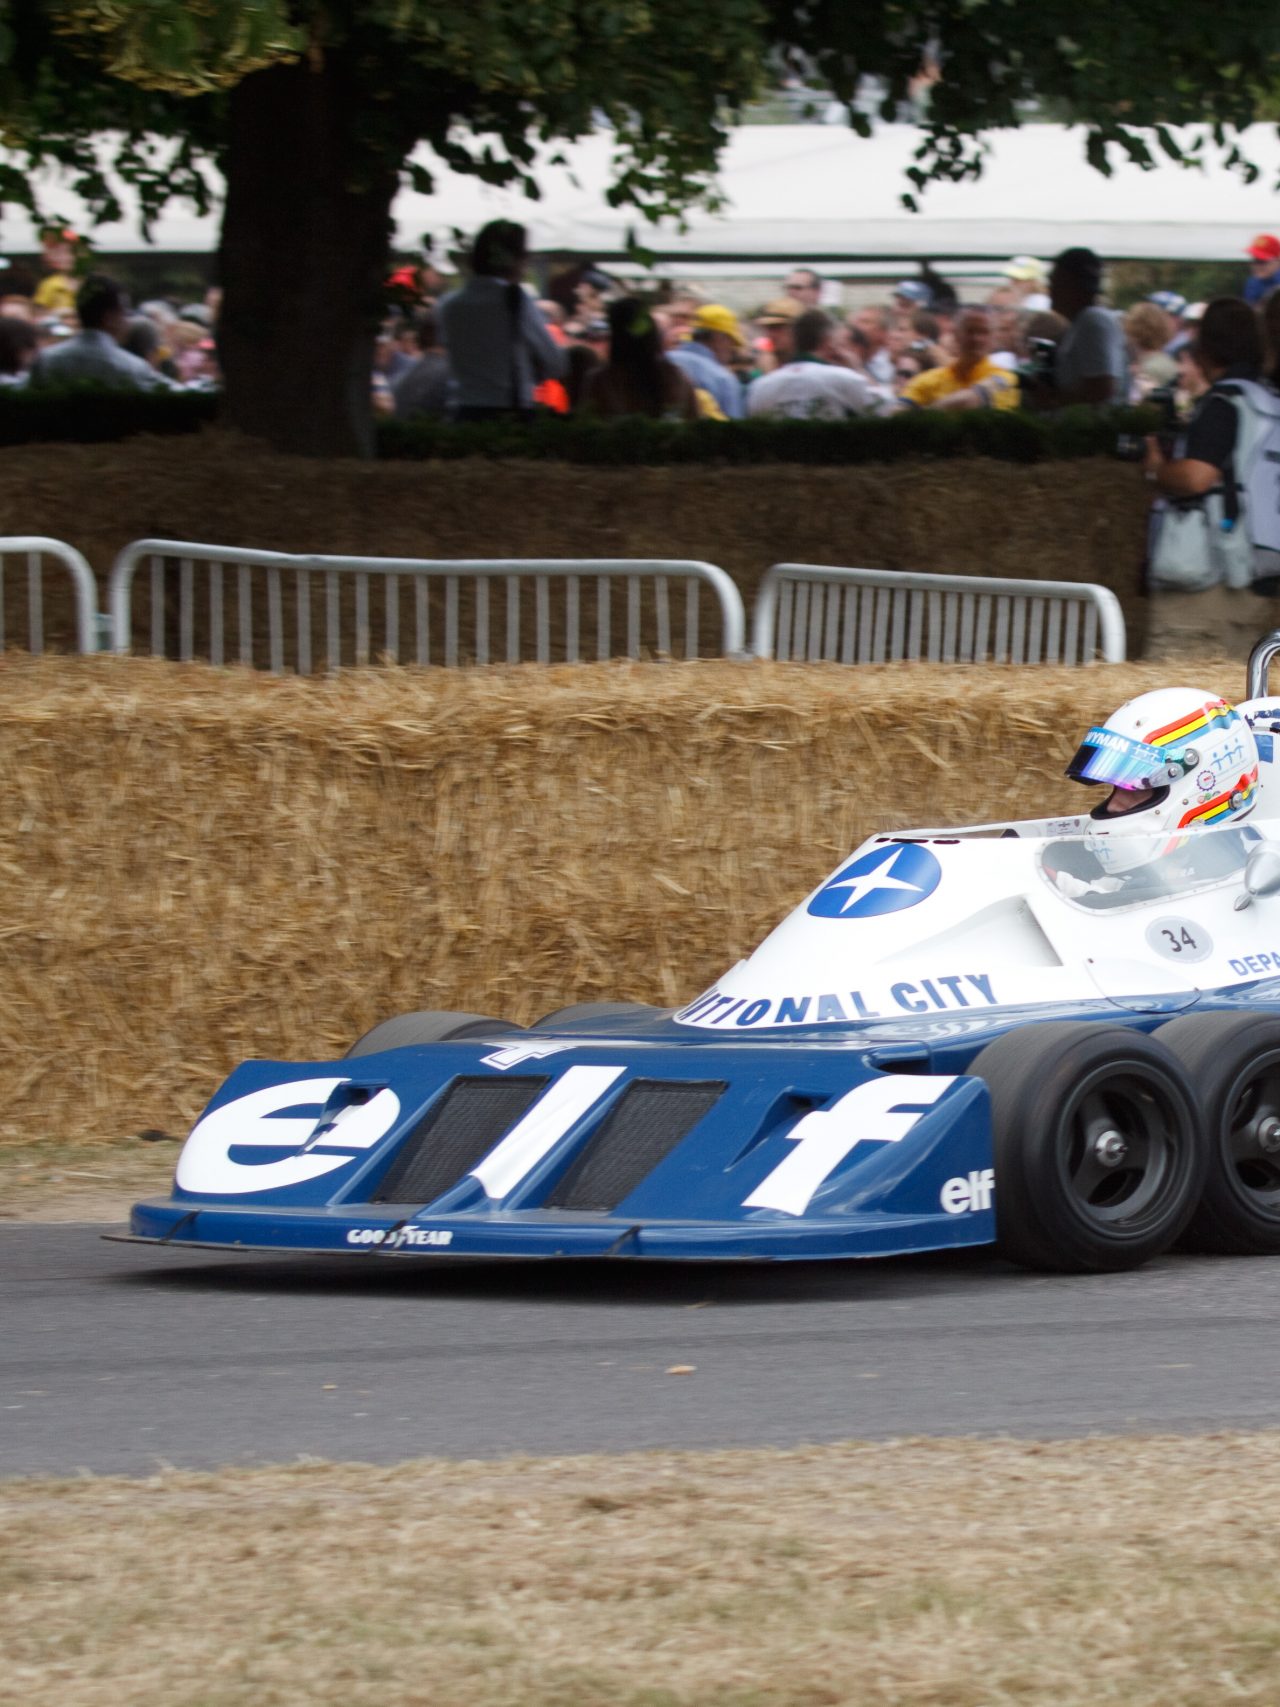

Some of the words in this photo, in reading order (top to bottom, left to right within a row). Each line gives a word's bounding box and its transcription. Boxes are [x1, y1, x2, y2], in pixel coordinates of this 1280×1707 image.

[1161, 926, 1197, 952] 34
[889, 973, 999, 1013] CITY
[940, 1168, 996, 1214] elf
